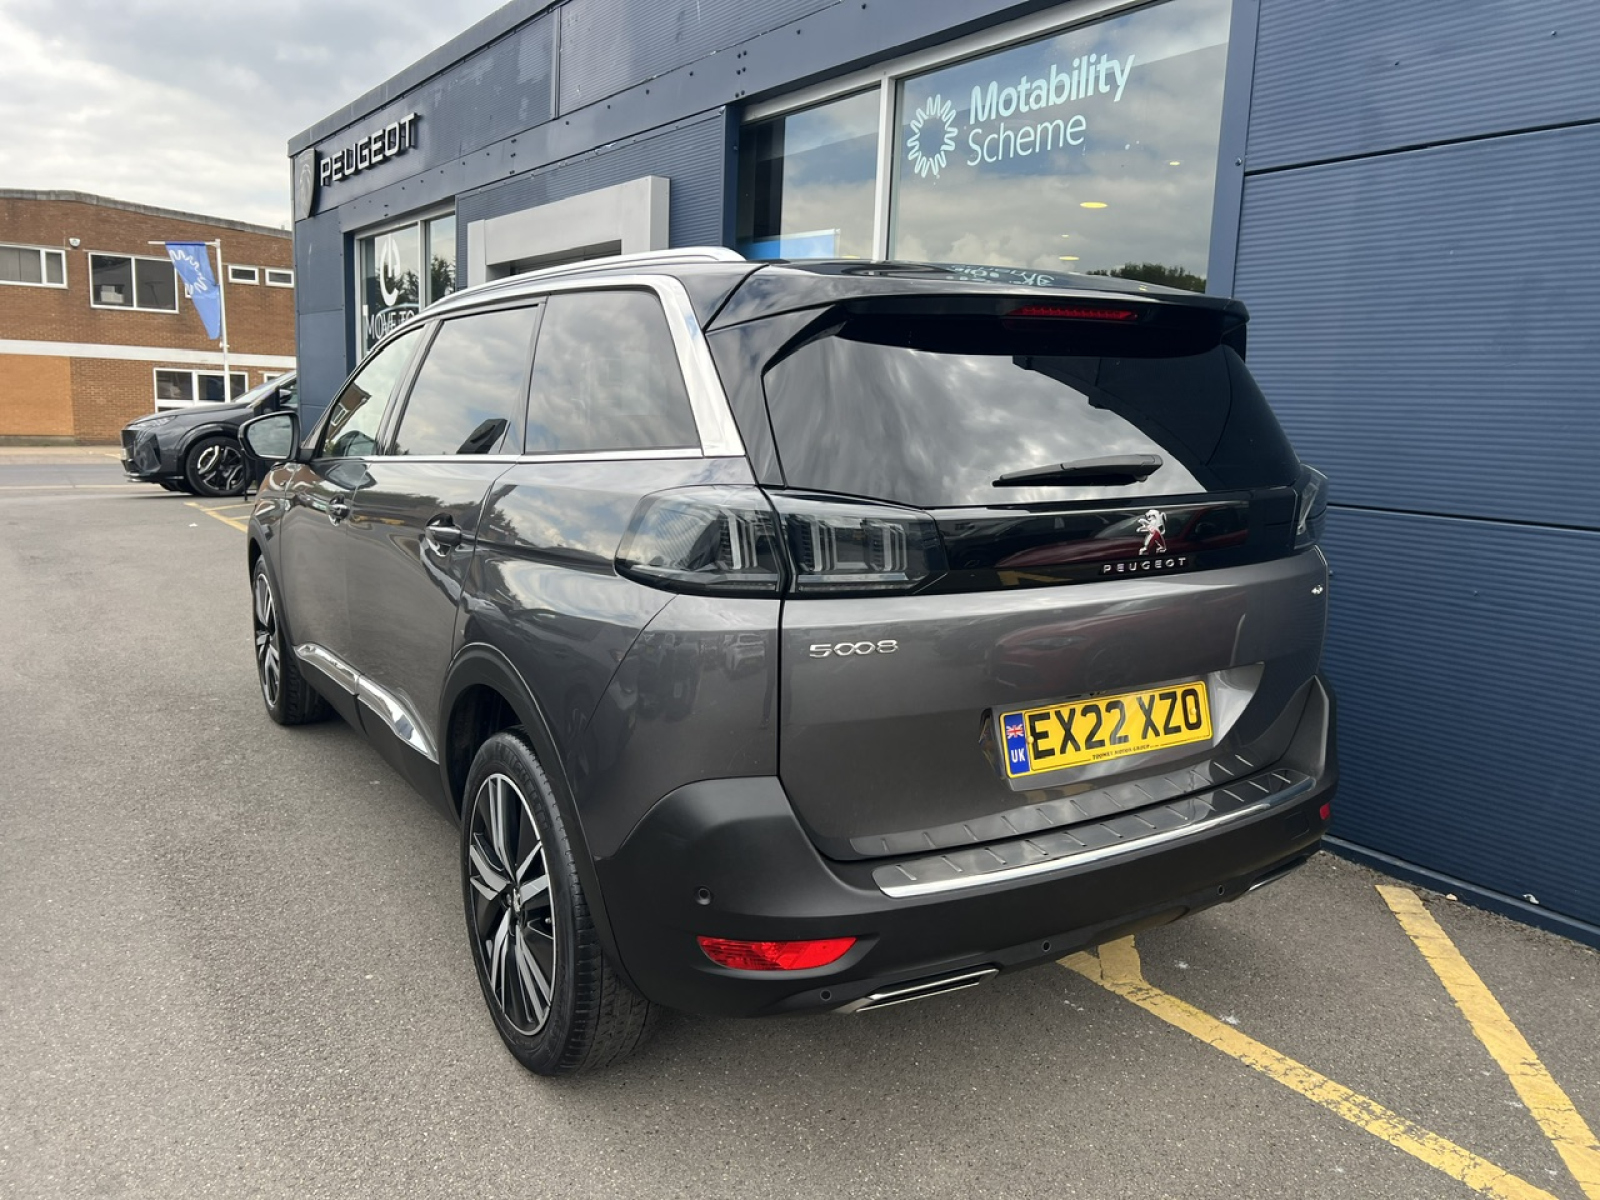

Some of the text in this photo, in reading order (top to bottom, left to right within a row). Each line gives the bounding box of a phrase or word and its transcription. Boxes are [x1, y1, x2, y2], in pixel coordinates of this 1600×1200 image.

[969, 53, 1136, 125] Motability
[320, 112, 416, 187] PEUGEOT
[967, 114, 1087, 166] Scheme
[1103, 557, 1186, 574] PEUGEOT
[809, 639, 899, 658] 5008
[1028, 688, 1202, 760] EX22 XZO
[1010, 747, 1026, 763] UK
